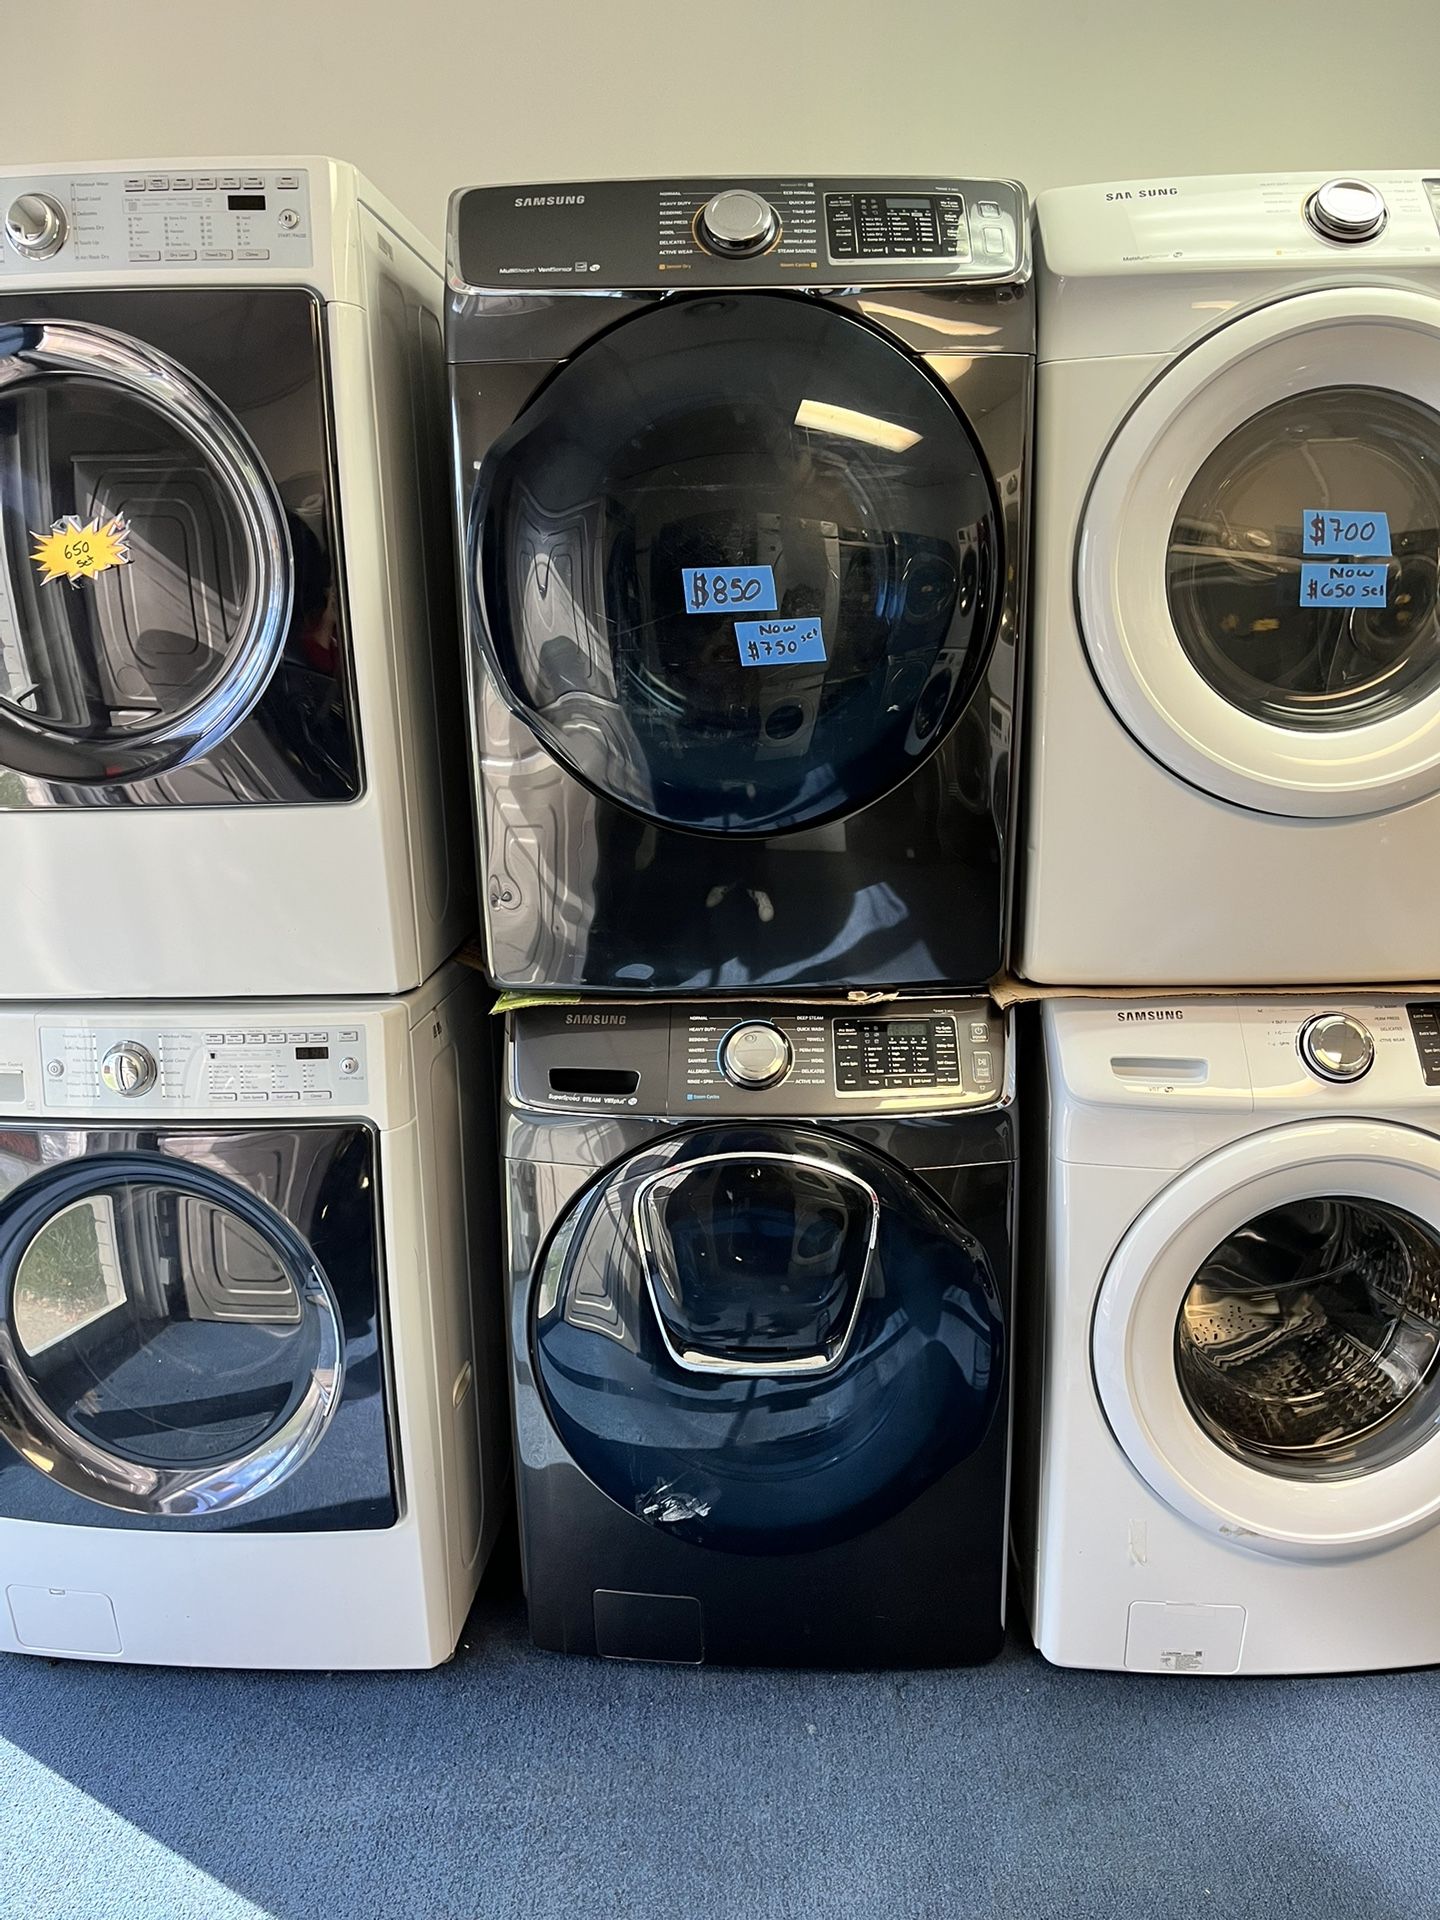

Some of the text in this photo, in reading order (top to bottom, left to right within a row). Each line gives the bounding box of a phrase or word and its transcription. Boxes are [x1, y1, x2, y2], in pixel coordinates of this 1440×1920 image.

[513, 194, 586, 208] SAMSUNG
[1308, 511, 1376, 547] $700
[63, 539, 90, 560] 650
[76, 554, 95, 568] set
[1329, 566, 1375, 580] Now
[690, 570, 763, 610] $850
[1306, 578, 1357, 601] $650
[758, 622, 797, 636] Now
[746, 639, 799, 662] $750
[564, 1013, 628, 1026] SAMSUNG
[1116, 1009, 1185, 1022] SAMSUNG
[582, 1095, 602, 1104] STEAM
